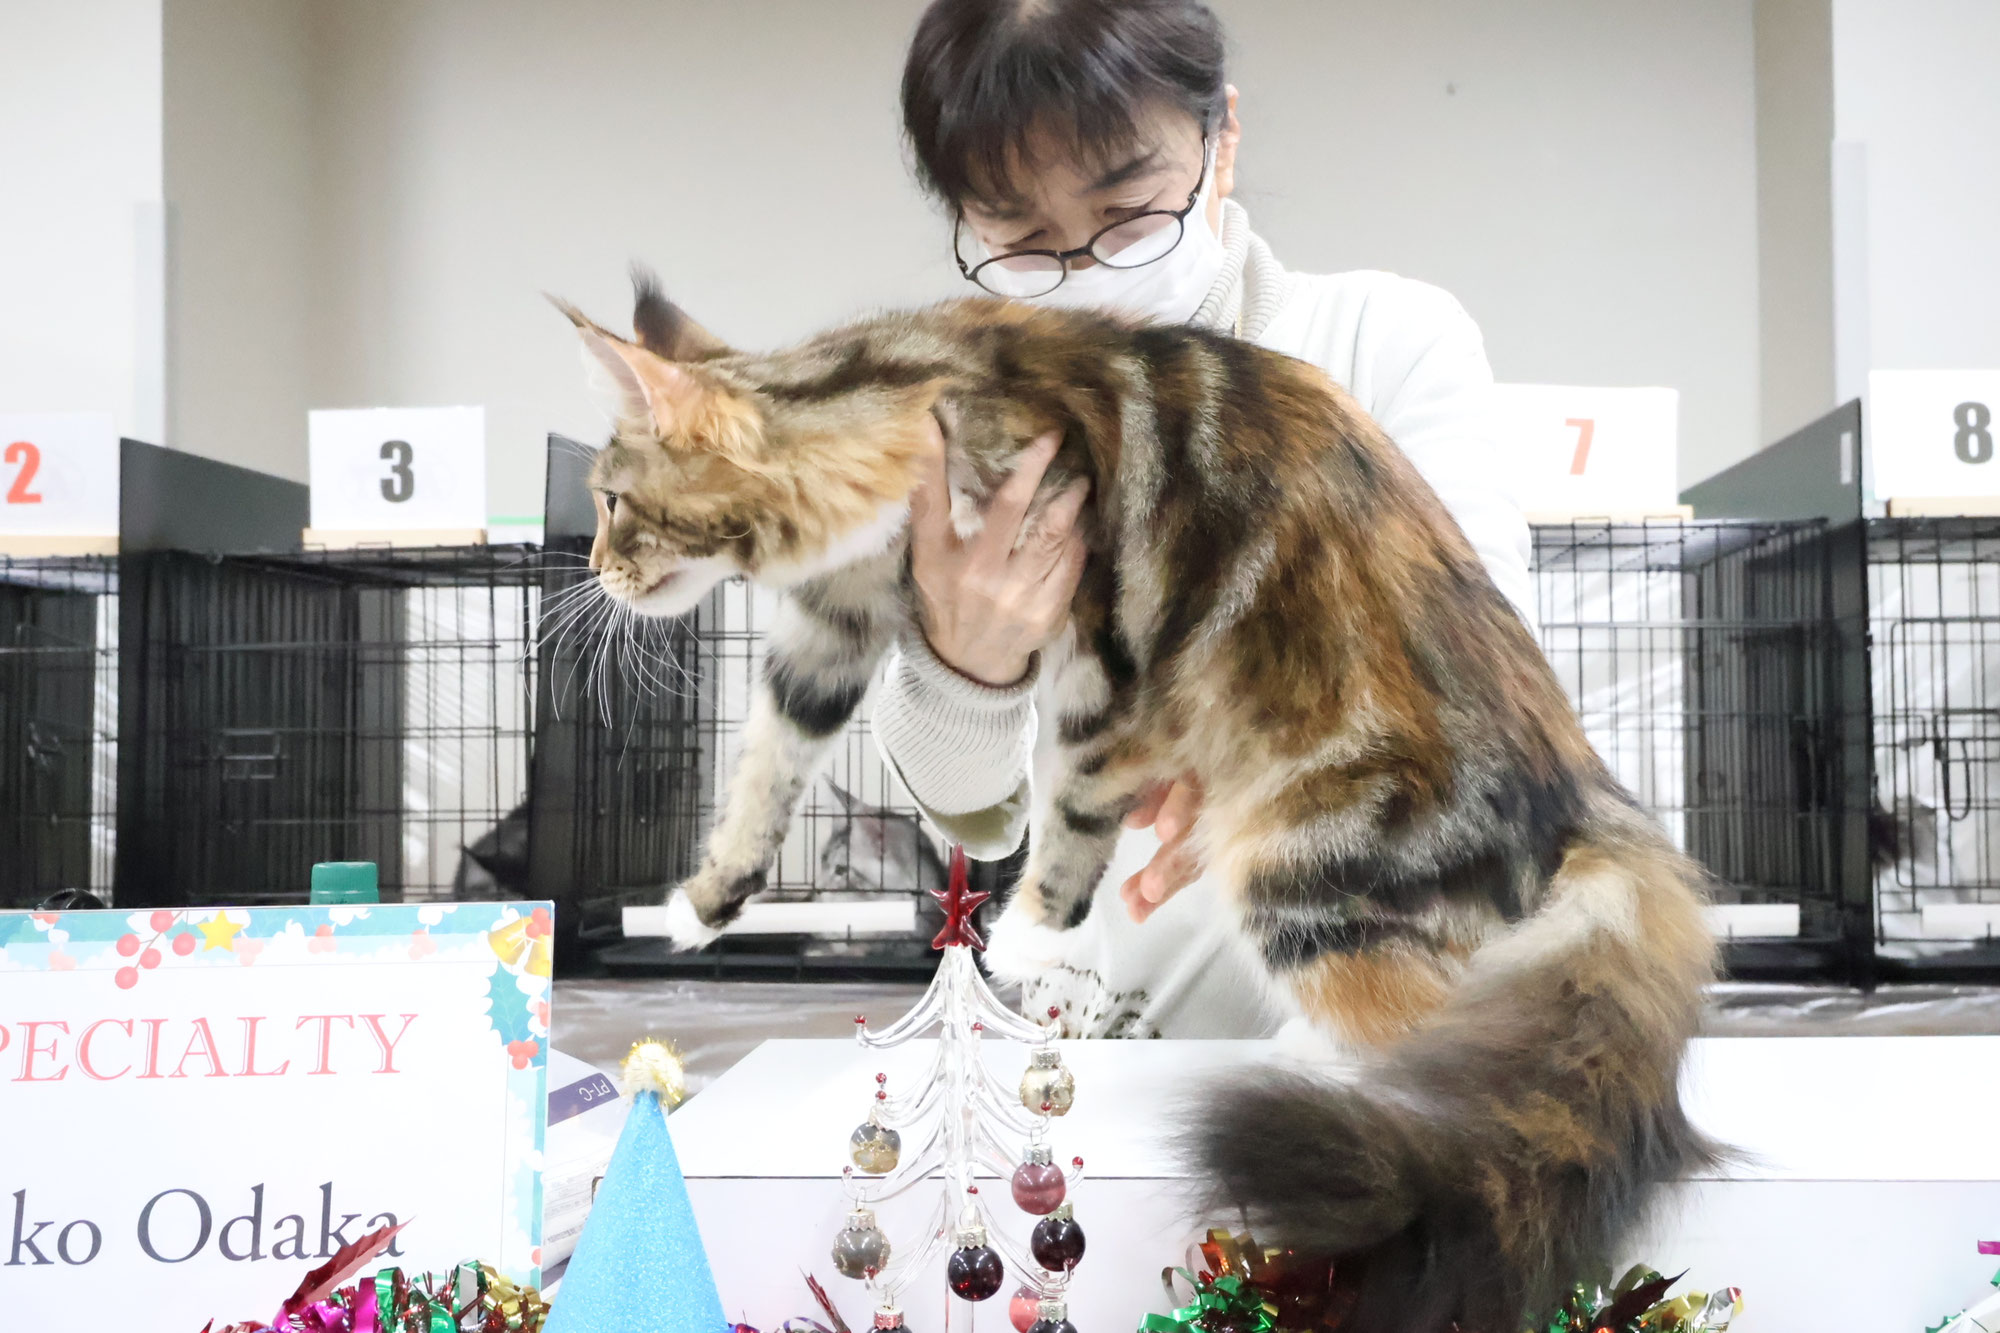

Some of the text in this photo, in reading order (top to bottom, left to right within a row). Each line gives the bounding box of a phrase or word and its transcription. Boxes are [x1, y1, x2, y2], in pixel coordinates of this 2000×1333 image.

[1564, 418, 1595, 476] 7
[1953, 401, 1993, 464] 8
[4, 441, 42, 504] 2
[379, 440, 415, 503] 3
[578, 1079, 611, 1102] PT-C
[3, 1188, 103, 1266] ko
